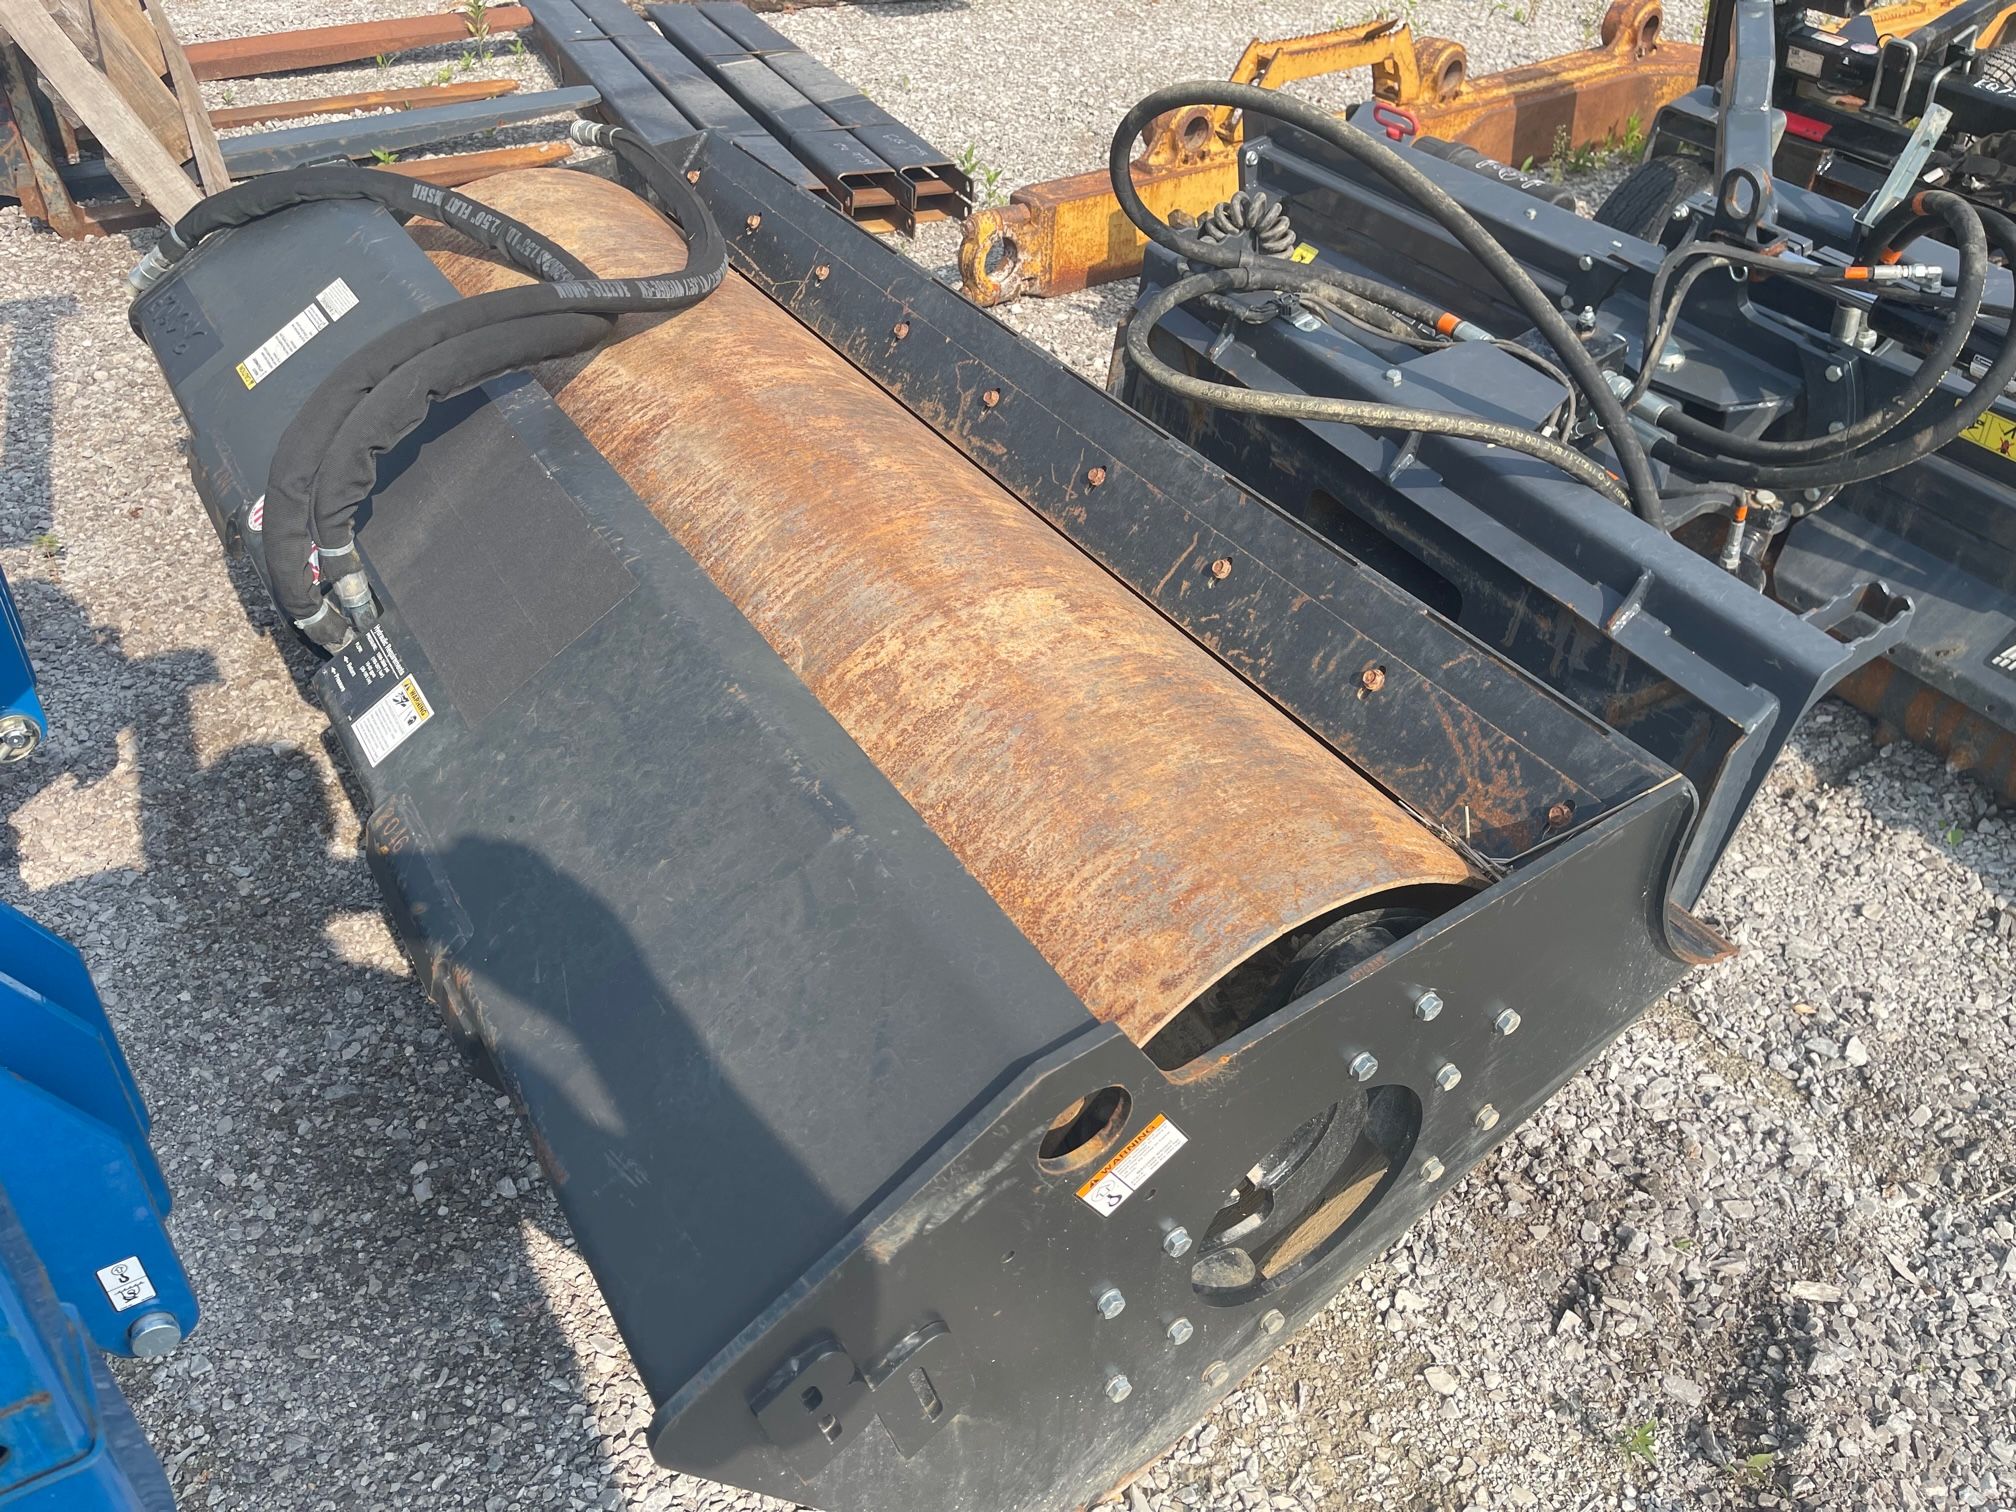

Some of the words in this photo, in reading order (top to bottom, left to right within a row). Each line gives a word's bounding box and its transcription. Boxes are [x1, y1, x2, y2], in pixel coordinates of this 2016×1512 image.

[412, 183, 446, 206] MSHA
[444, 196, 473, 220] FLAT
[1524, 433, 1540, 447] 100
[1542, 440, 1563, 456] SAE
[373, 623, 388, 647] Hydraulic
[385, 643, 405, 676] Requirements
[347, 661, 356, 678] Return
[333, 672, 346, 693] Pressure
[409, 689, 427, 716] WARNING
[1100, 1124, 1154, 1173] WARNING
